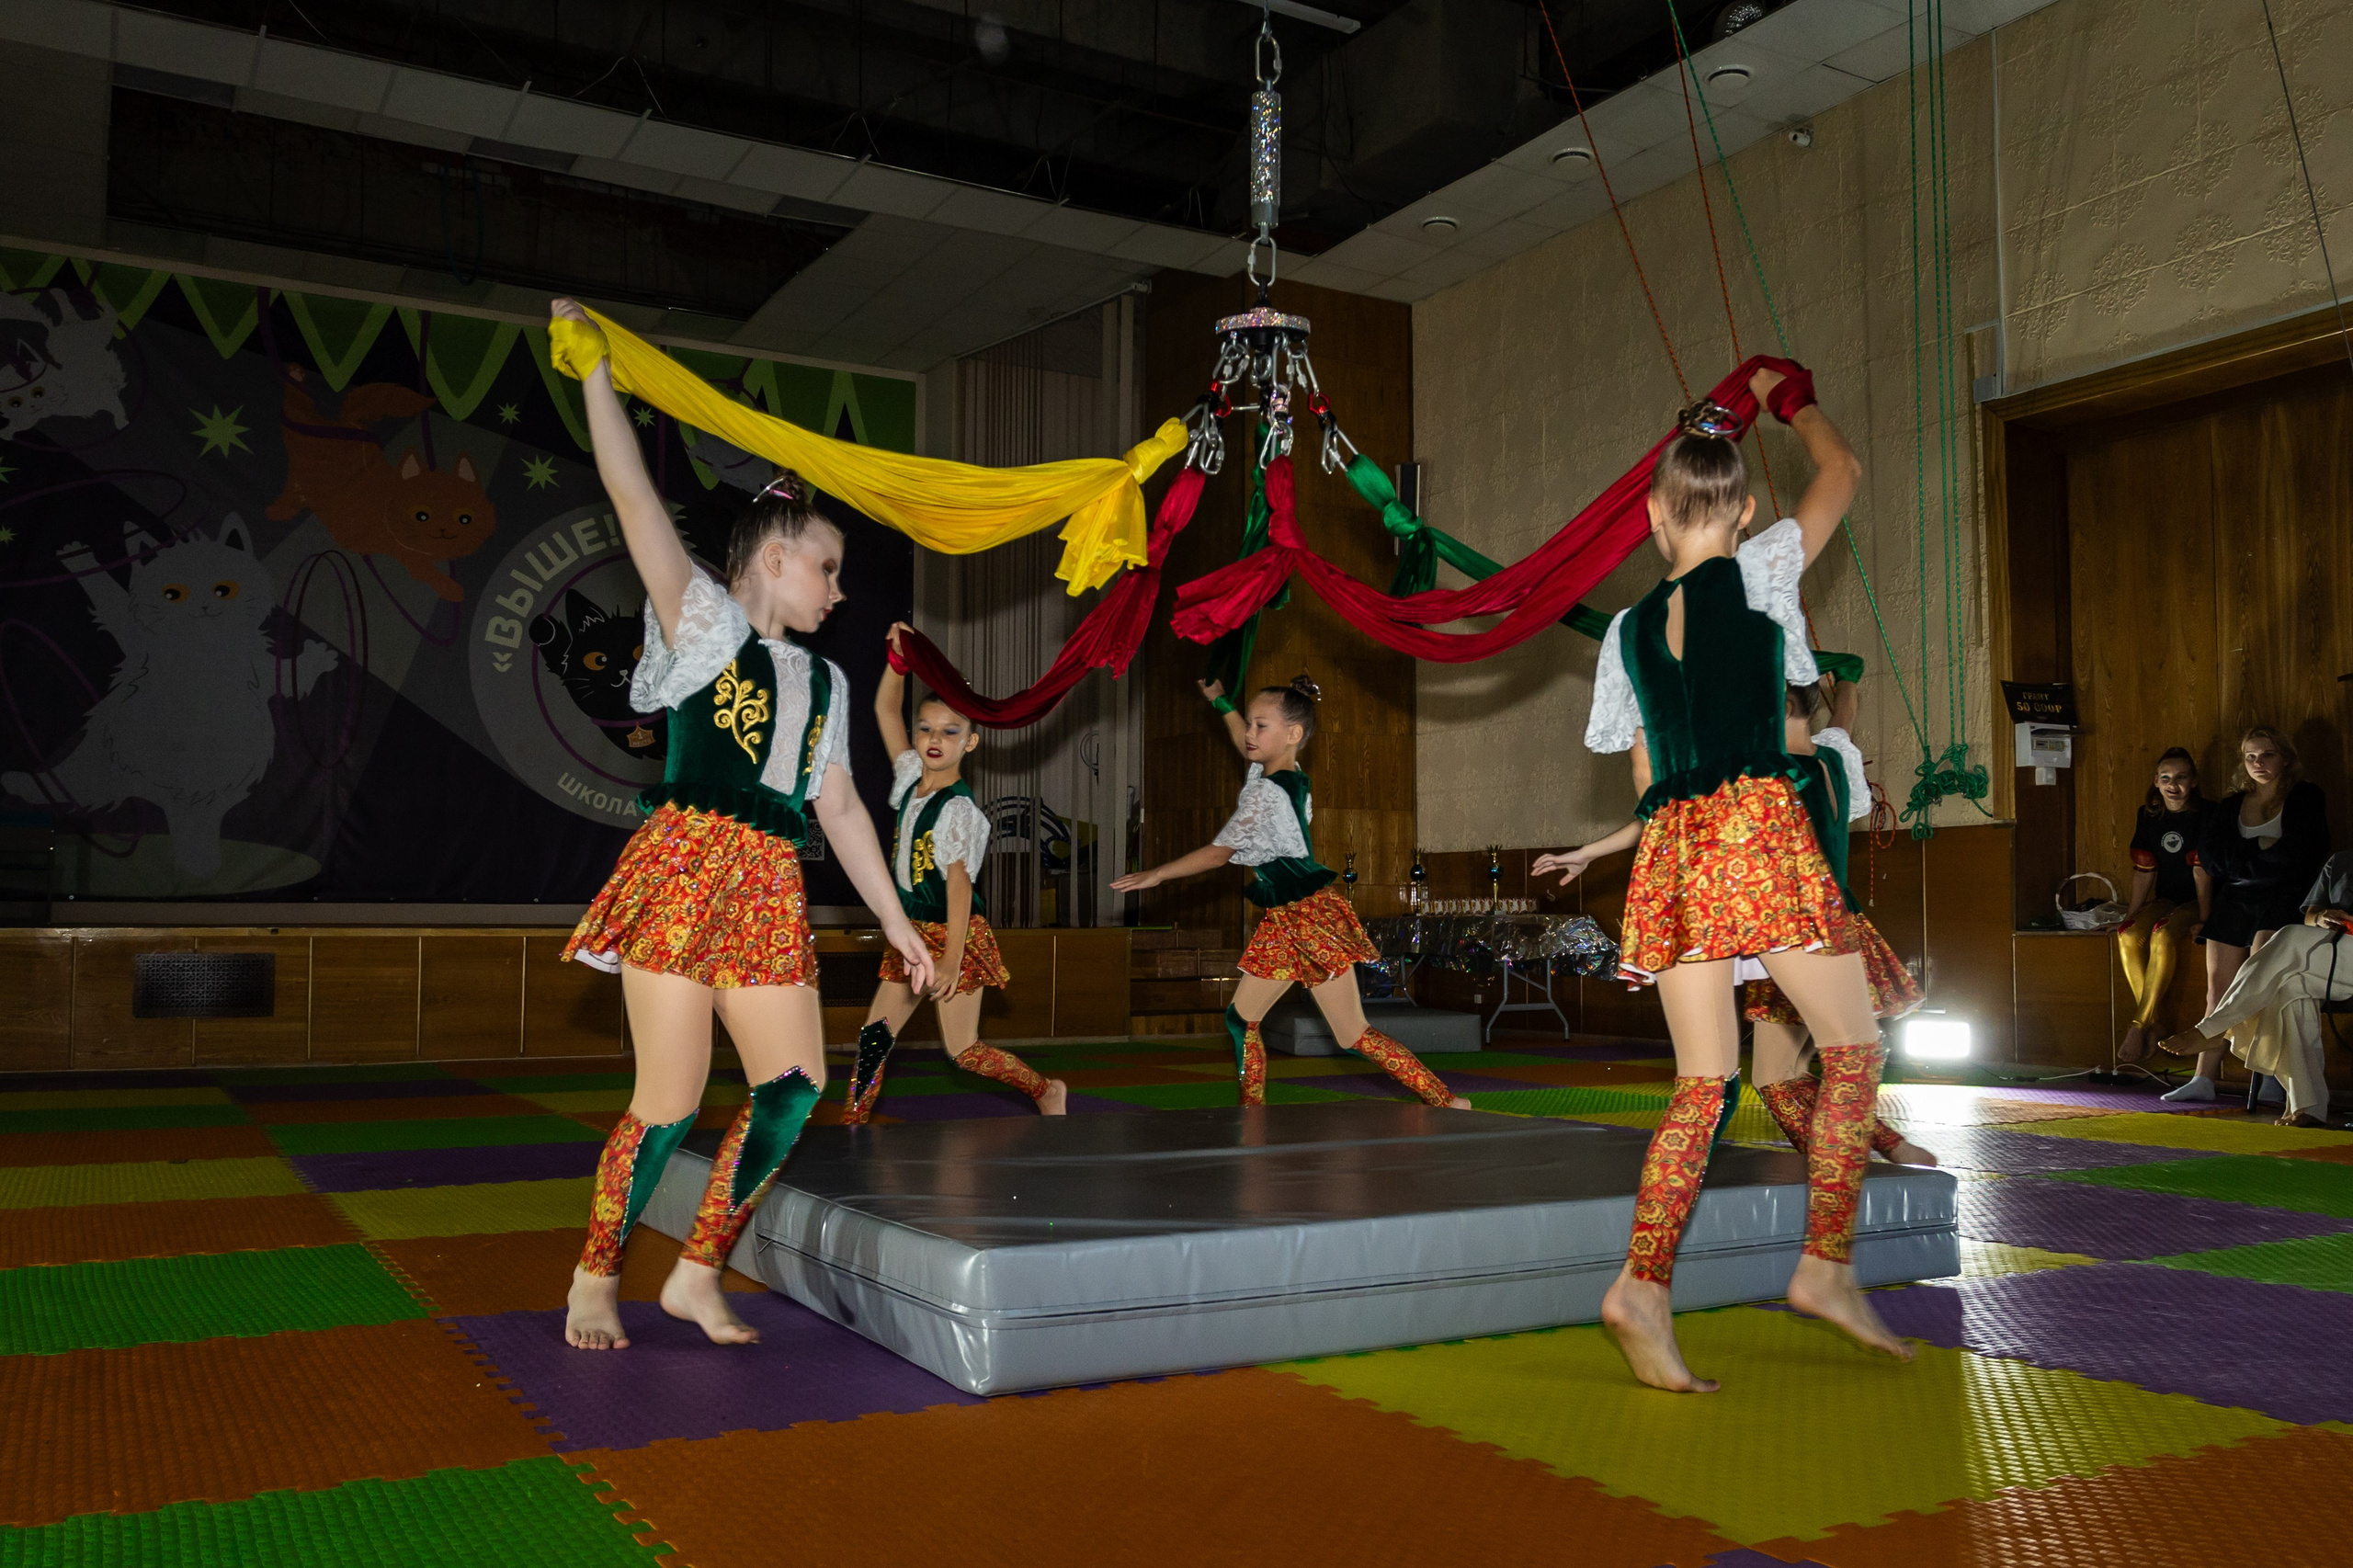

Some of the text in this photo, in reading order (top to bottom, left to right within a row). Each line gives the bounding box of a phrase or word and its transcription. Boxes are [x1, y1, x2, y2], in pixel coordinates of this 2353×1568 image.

[484, 513, 620, 673] «ВЫШЕ!
[2017, 701, 2030, 711] 50
[637, 732, 643, 740] 1
[557, 771, 638, 817] ШКОЛА
